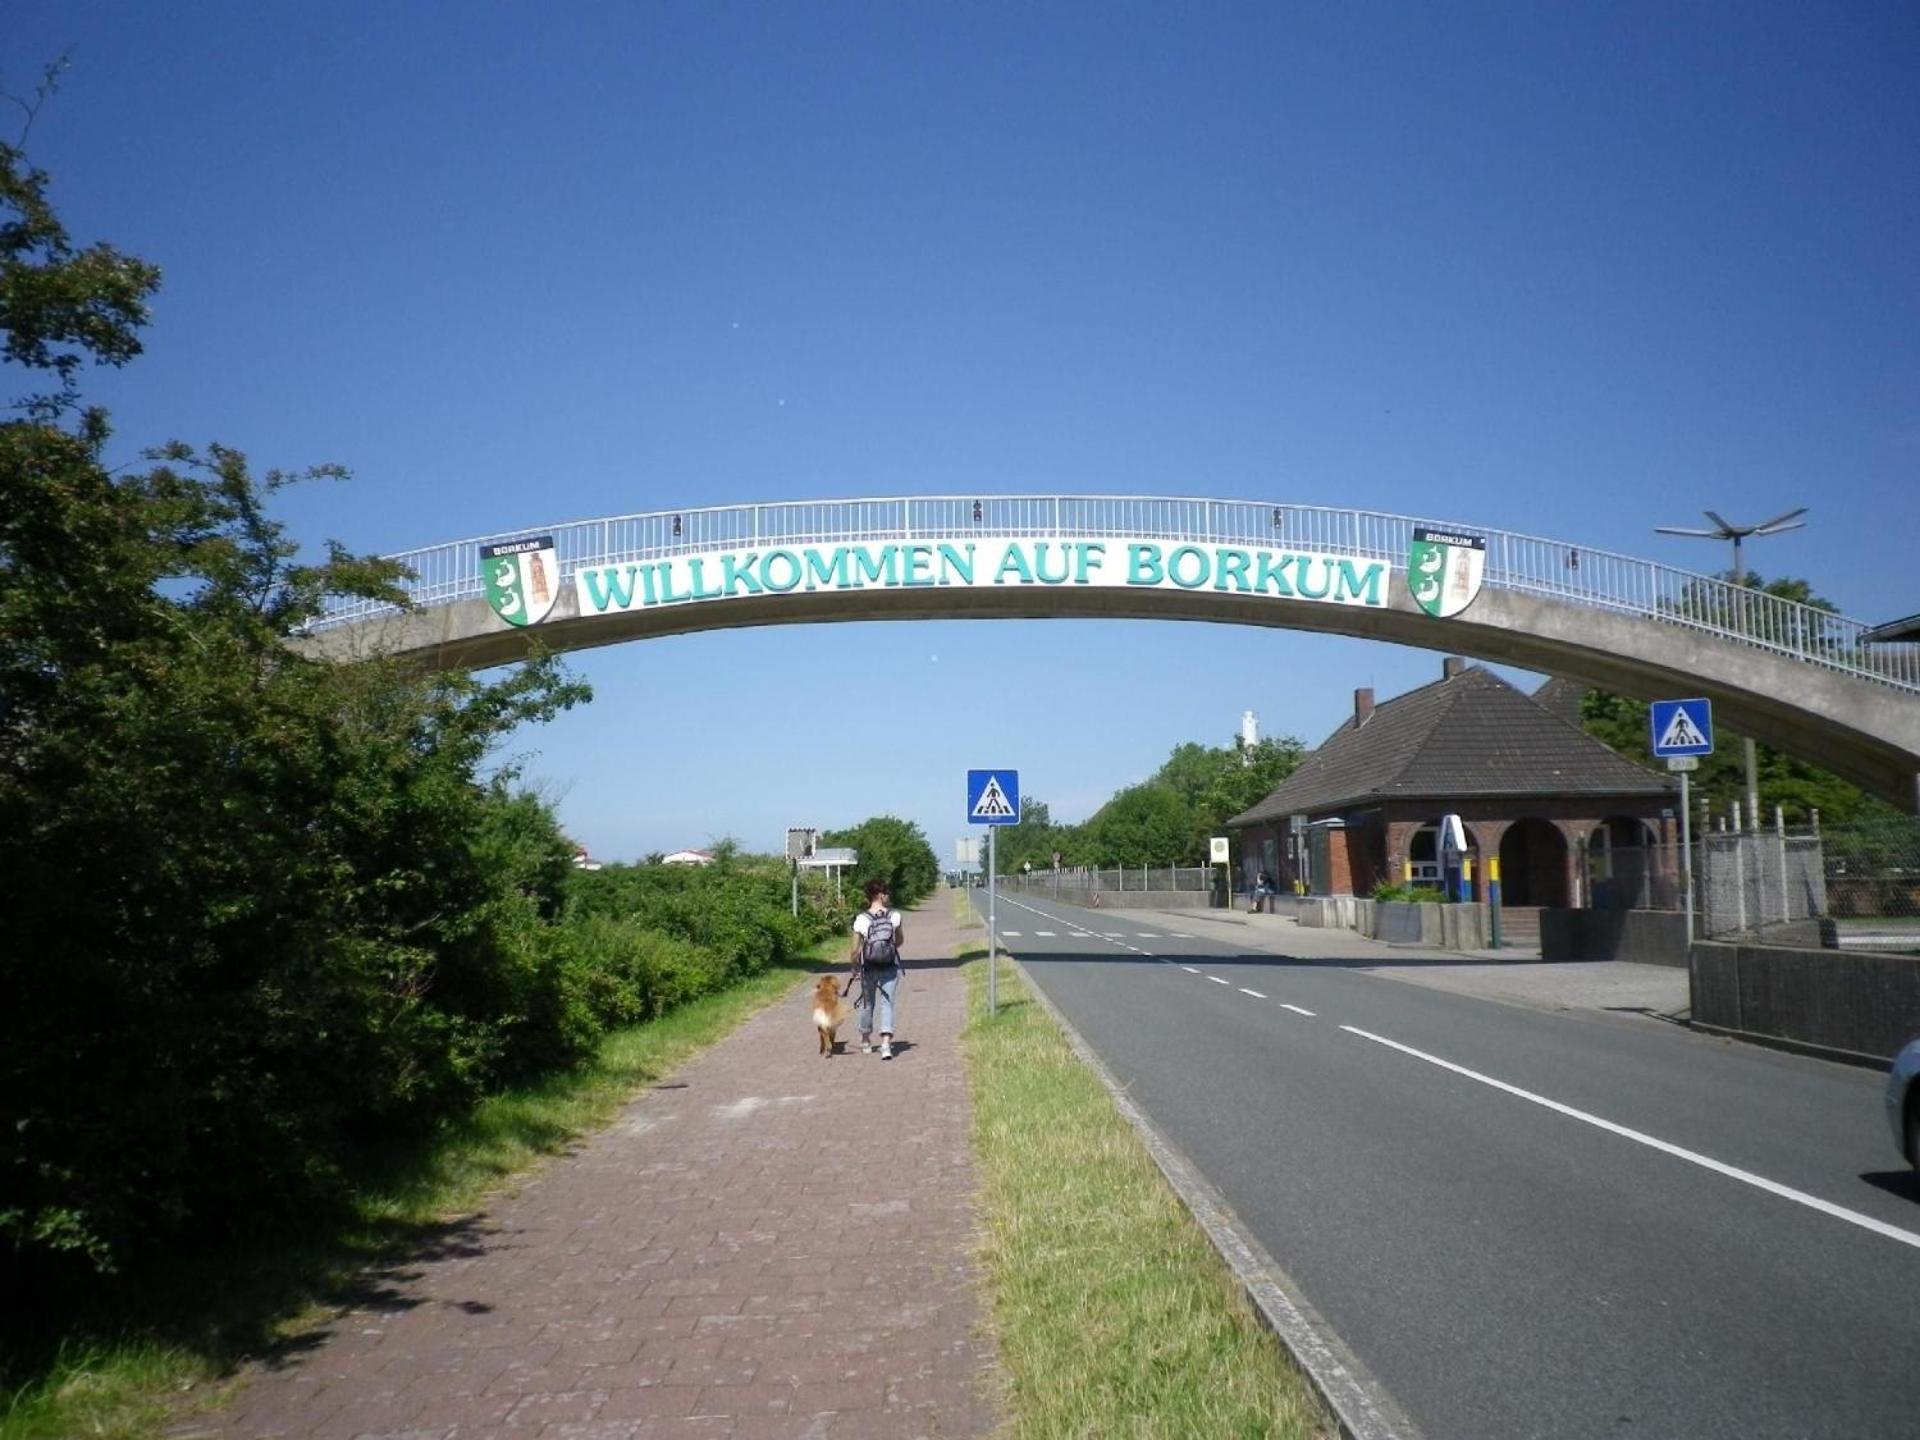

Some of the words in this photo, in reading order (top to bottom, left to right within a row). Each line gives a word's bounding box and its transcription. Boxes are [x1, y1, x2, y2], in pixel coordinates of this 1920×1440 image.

[1426, 533, 1473, 547] BORKUM
[493, 541, 540, 556] BORKUM
[583, 543, 976, 612] WILLKOMMEN
[994, 542, 1106, 584] AUF
[1126, 543, 1384, 605] BORKUM
